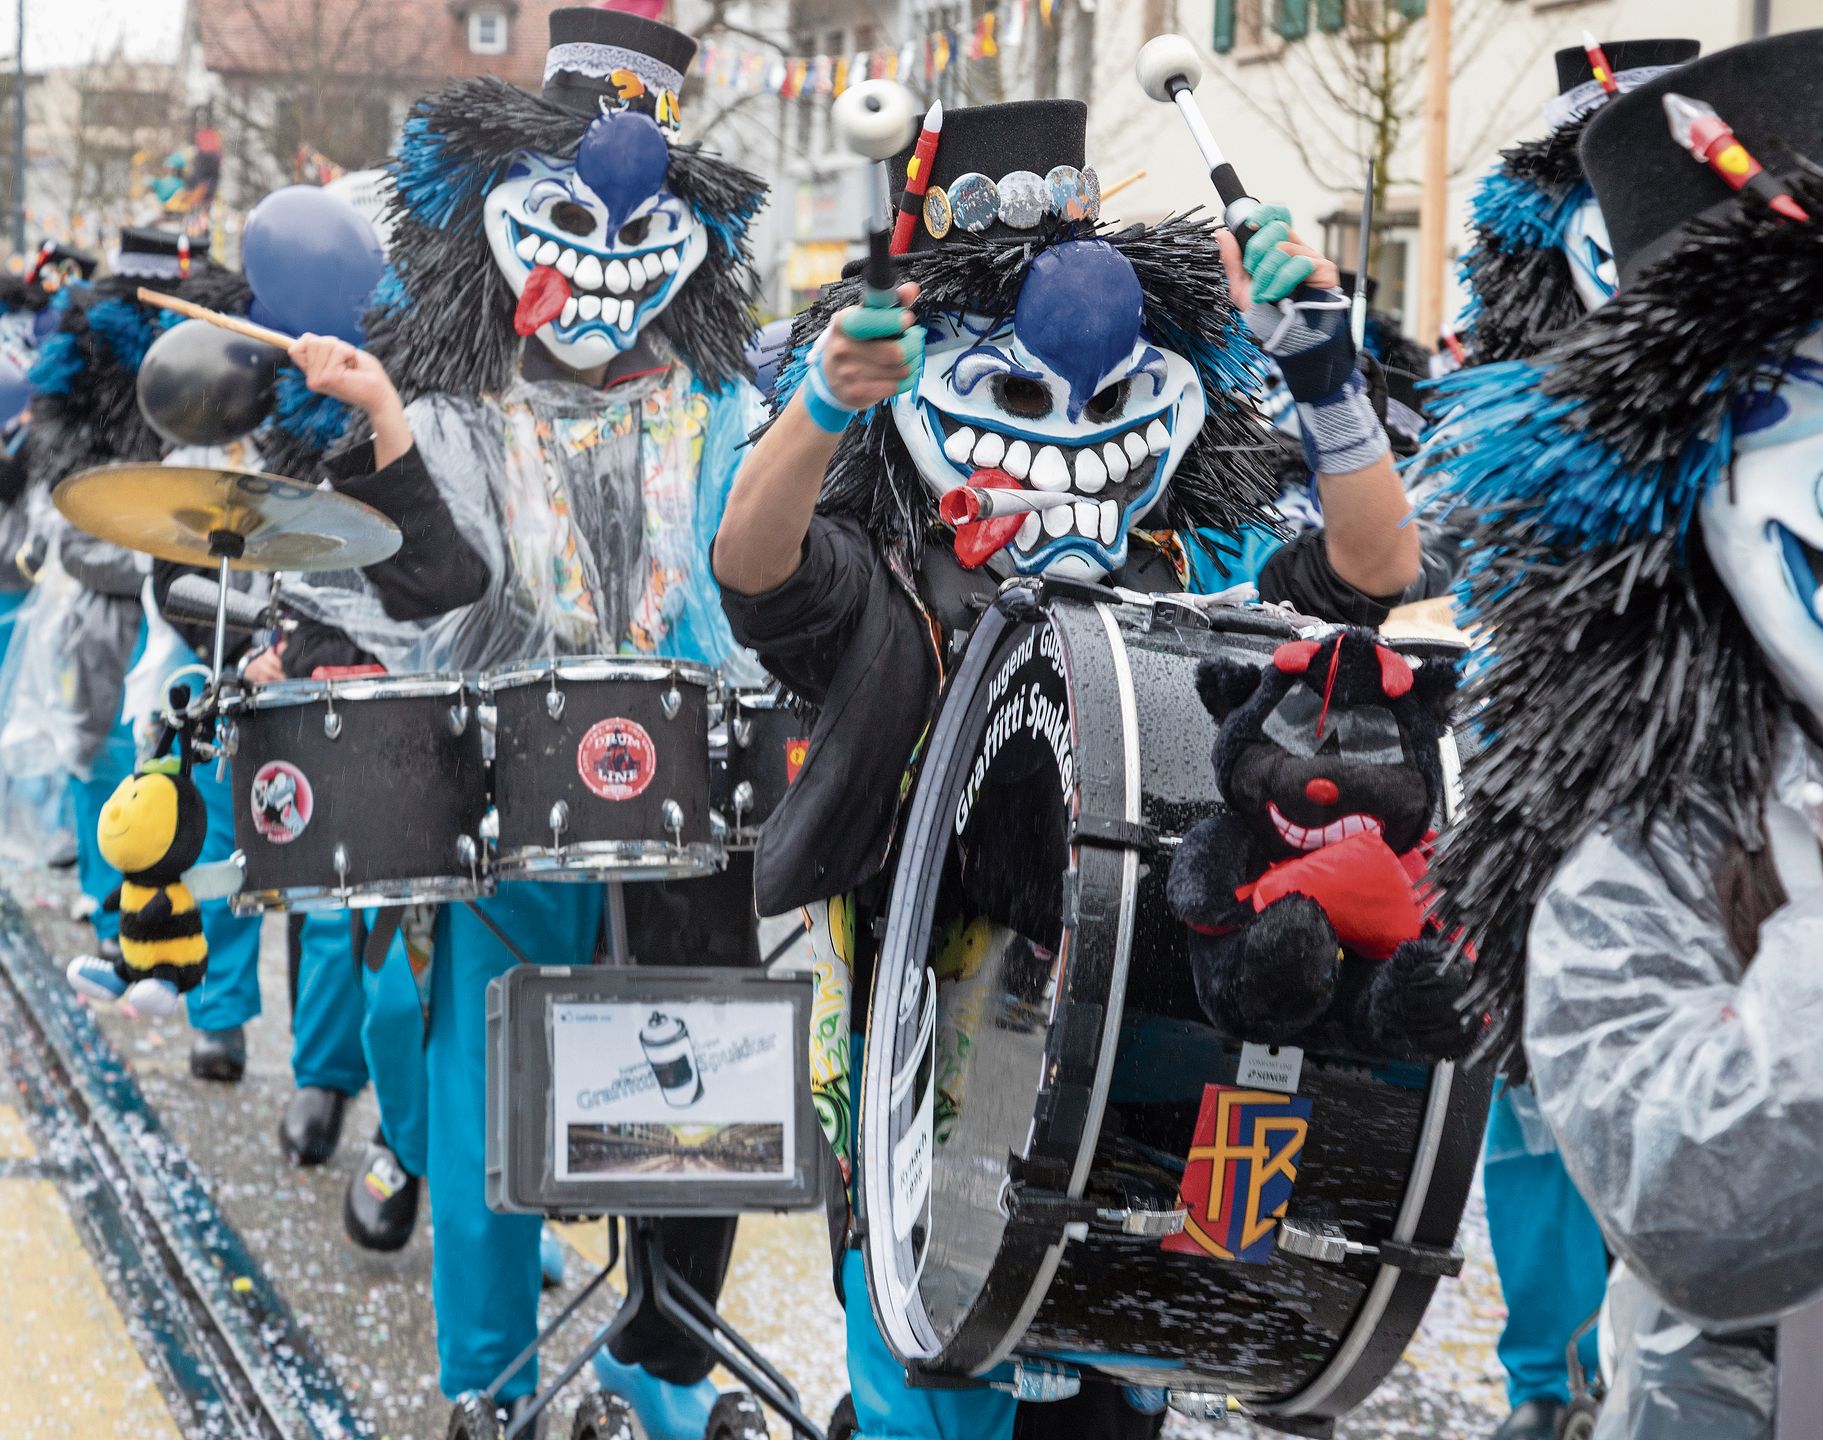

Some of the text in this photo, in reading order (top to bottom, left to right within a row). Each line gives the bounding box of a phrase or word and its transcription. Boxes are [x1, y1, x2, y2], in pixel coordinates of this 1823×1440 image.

[986, 625, 1035, 714] Jugend
[595, 733, 640, 749] DRUM
[954, 681, 1074, 836] Graffitti Spukker
[598, 769, 637, 784] LINE
[1257, 1071, 1288, 1083] SONOR
